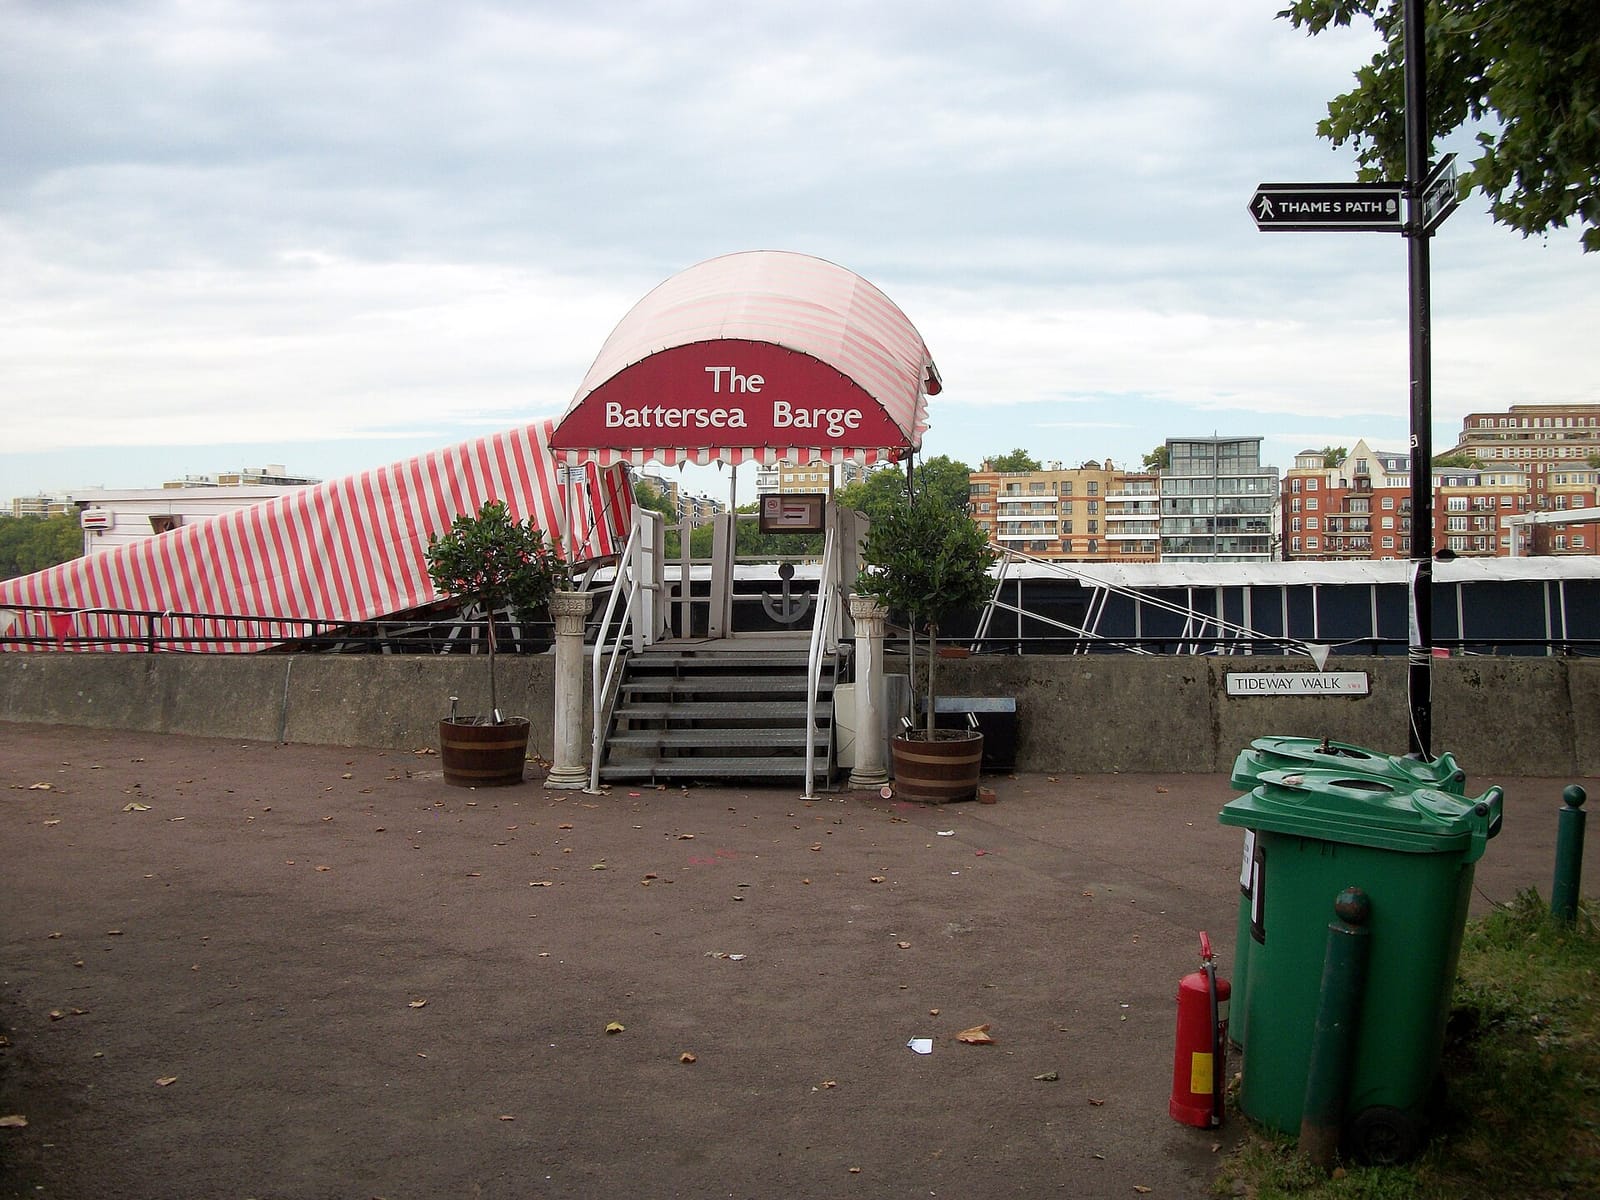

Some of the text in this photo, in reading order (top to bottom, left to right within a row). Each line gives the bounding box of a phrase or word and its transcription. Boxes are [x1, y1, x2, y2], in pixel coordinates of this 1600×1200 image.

[1278, 201, 1382, 213] THAMES PATH
[705, 366, 765, 393] The
[605, 401, 863, 438] Battersea Barge
[1235, 678, 1294, 690] TIDEWAY
[1301, 677, 1341, 689] WALK
